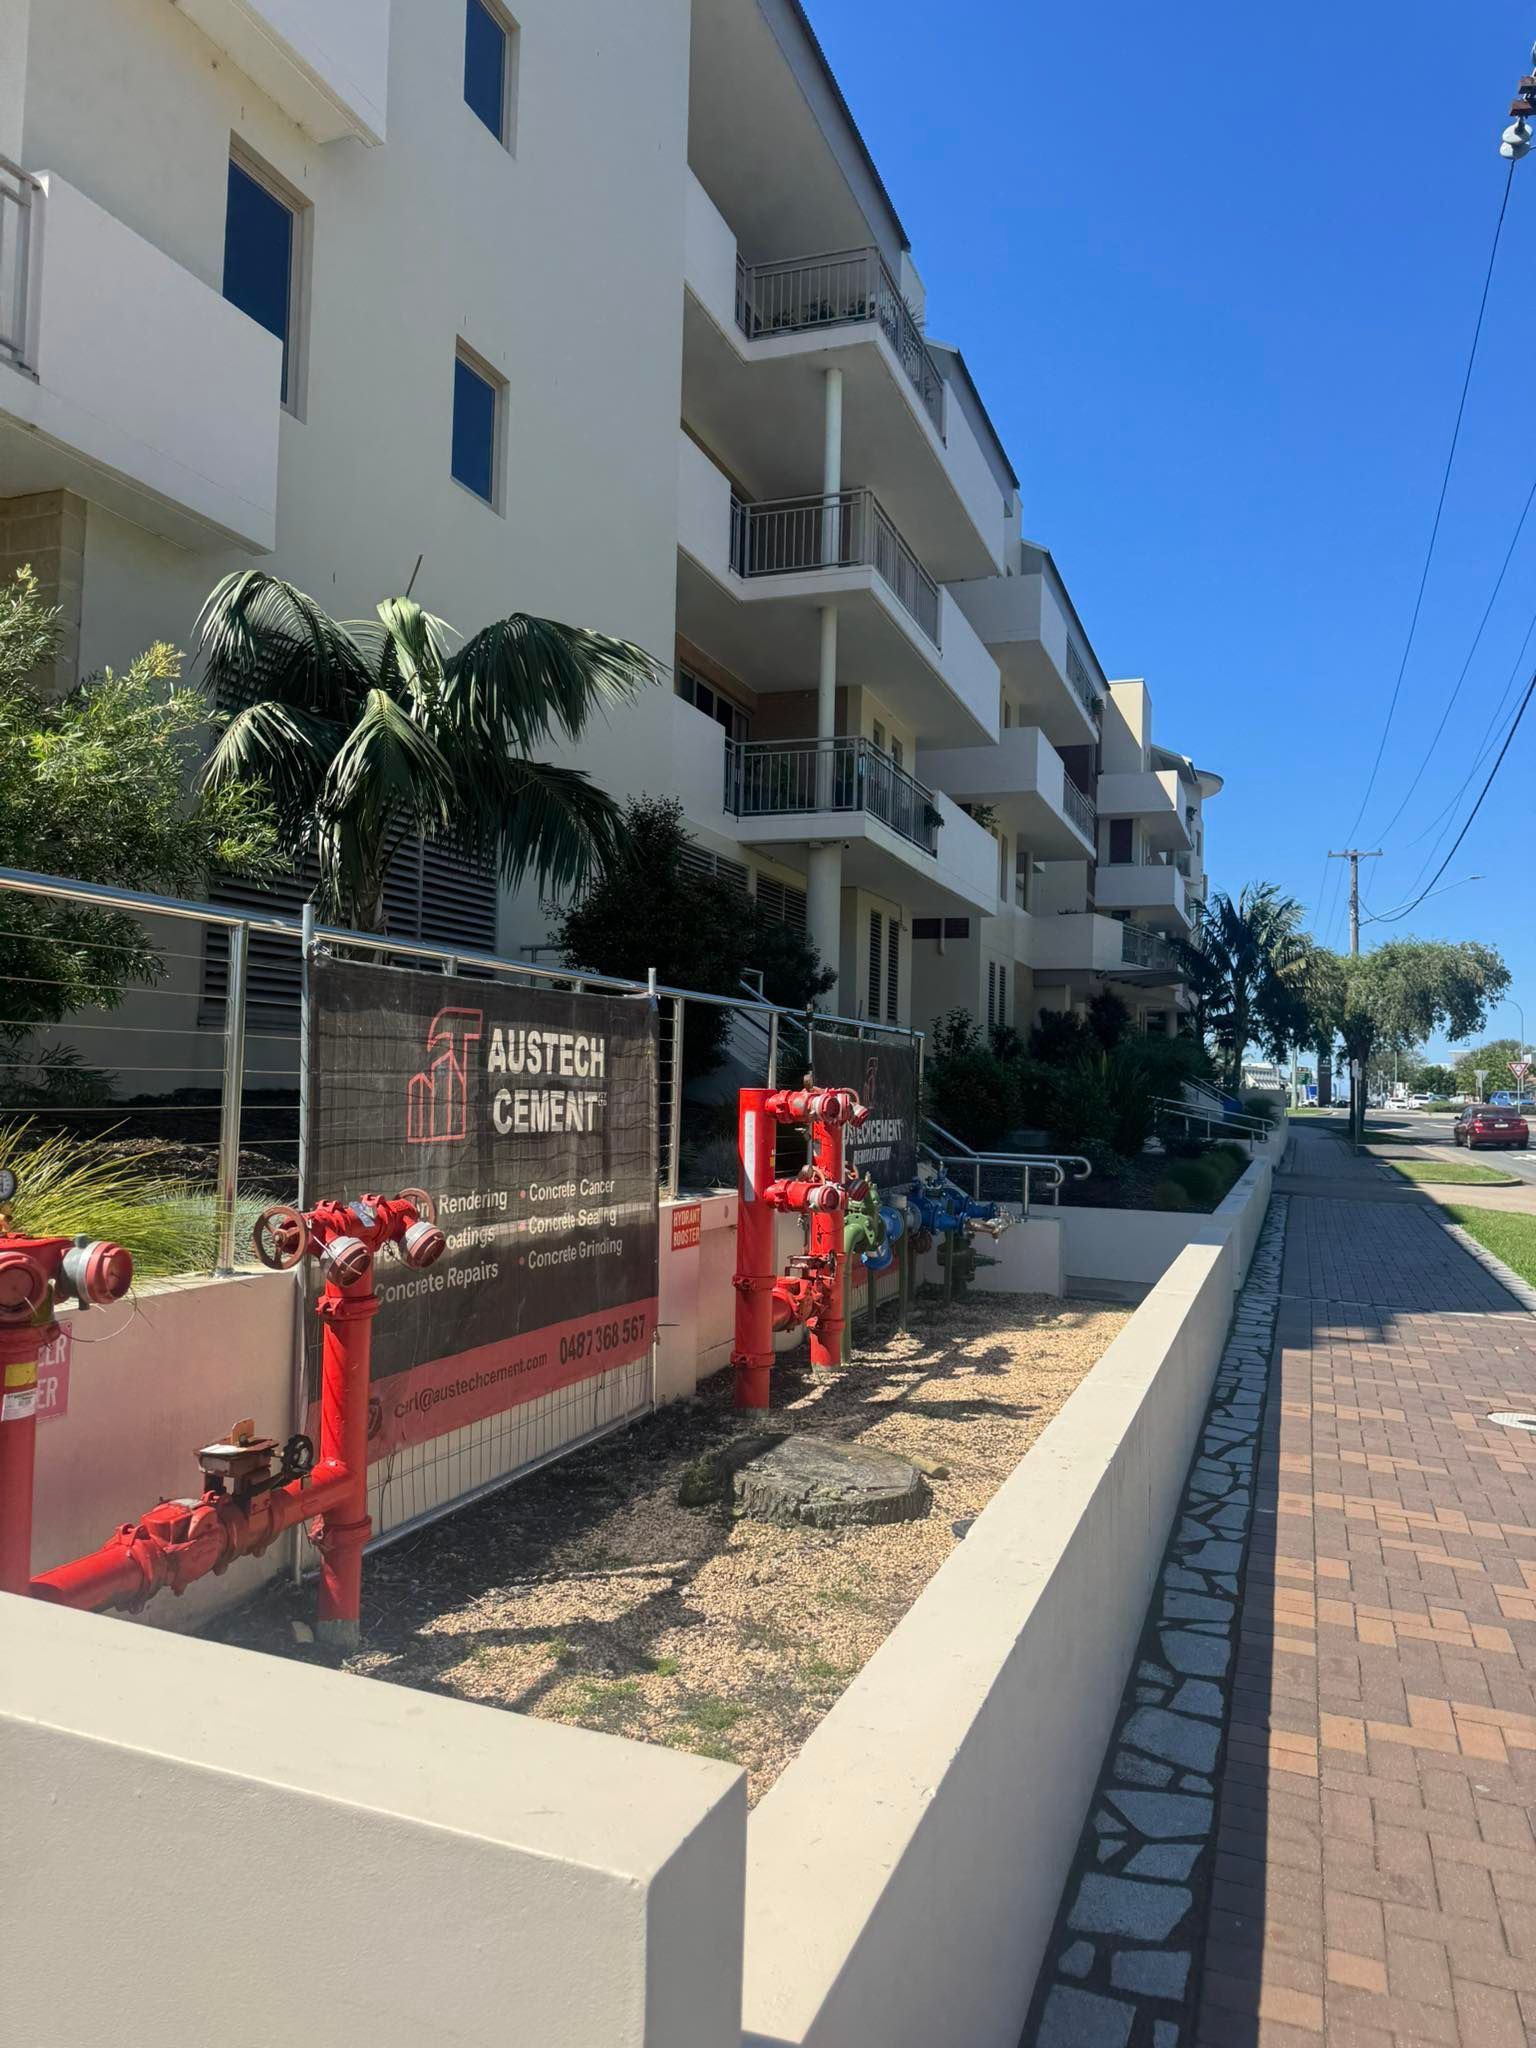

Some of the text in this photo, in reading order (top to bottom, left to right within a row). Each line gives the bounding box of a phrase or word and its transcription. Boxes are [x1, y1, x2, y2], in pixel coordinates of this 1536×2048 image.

[487, 1028, 605, 1078] AUSTECH
[493, 1088, 599, 1135] CEMENT
[439, 1188, 508, 1215] Rendering
[529, 1179, 615, 1202] Concrete Cancer
[445, 1226, 496, 1249] oatings
[528, 1212, 576, 1234] Concrete
[528, 1237, 623, 1270] Concrete Grinding
[374, 1260, 499, 1305] Concrete Repairs
[560, 1314, 646, 1365] 0487 368 567
